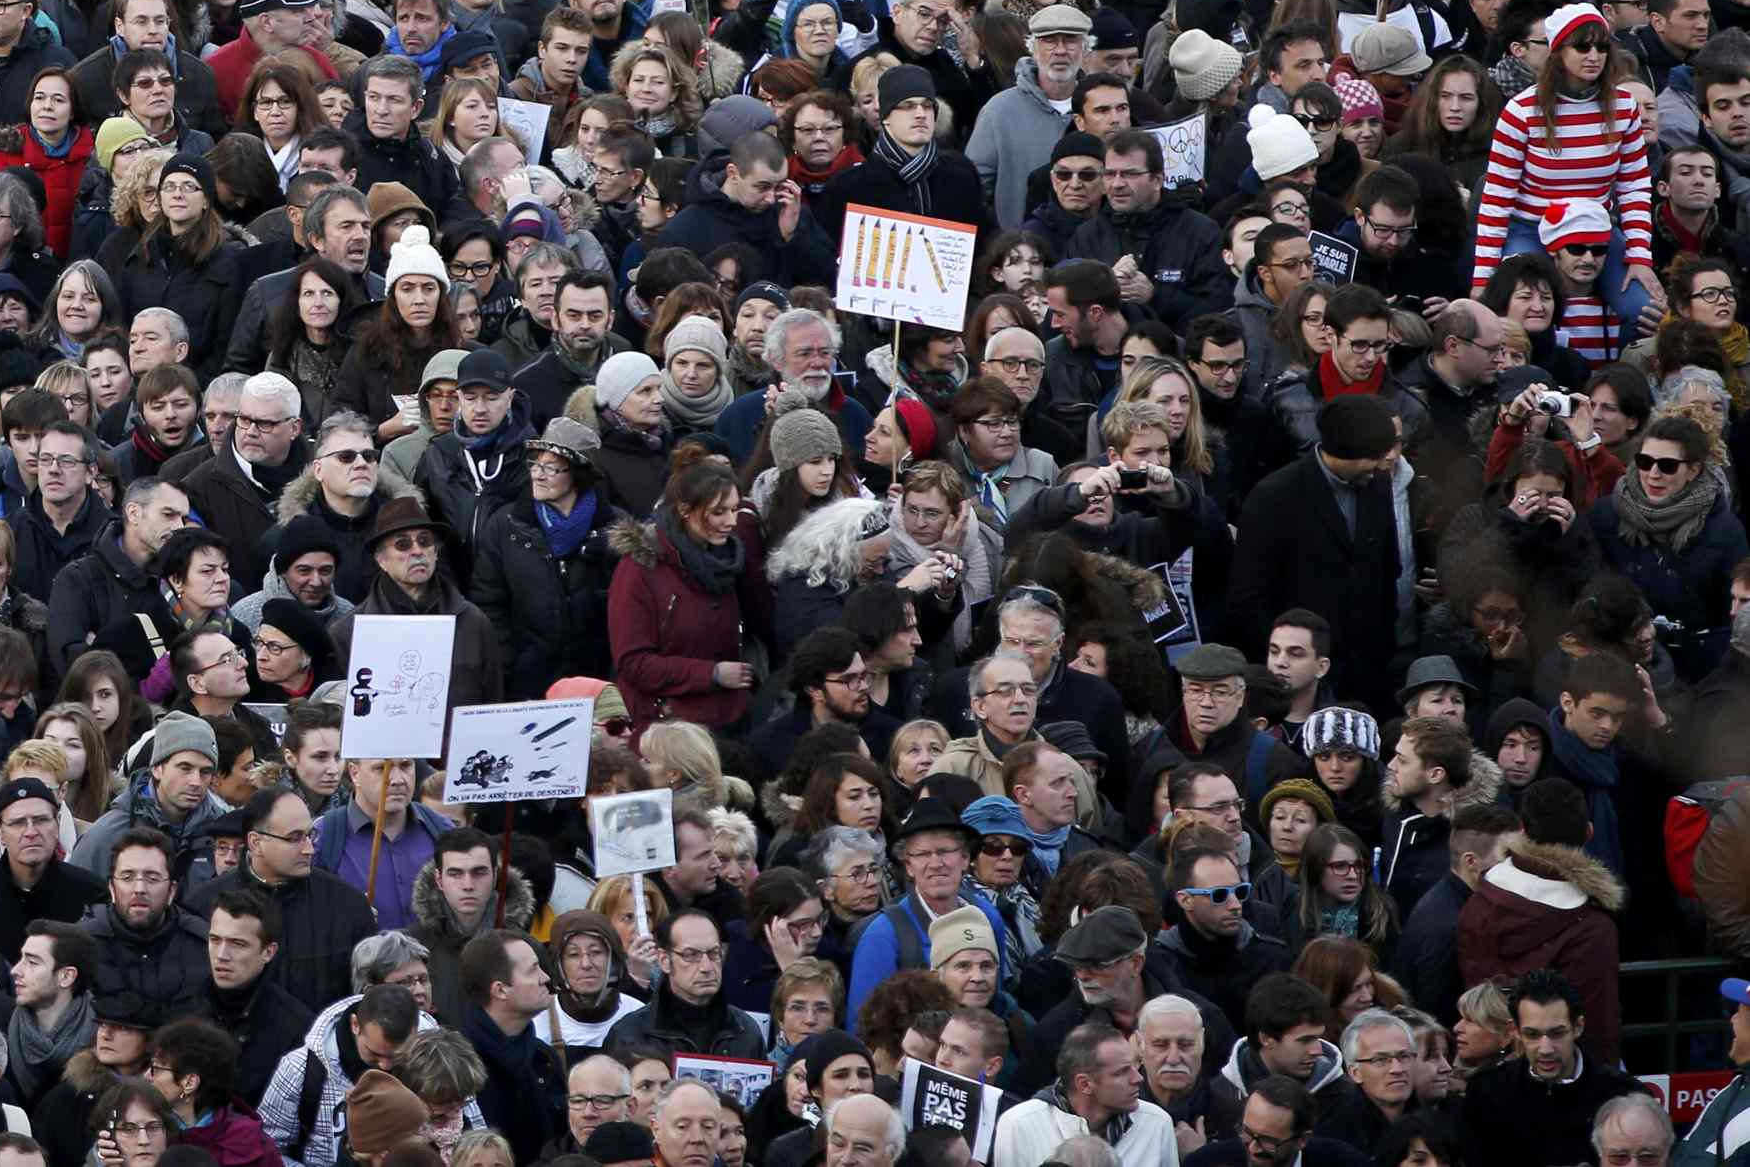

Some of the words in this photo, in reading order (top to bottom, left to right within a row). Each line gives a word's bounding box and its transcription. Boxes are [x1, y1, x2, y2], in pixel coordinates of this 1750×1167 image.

[1316, 244, 1330, 256] JE
[1329, 247, 1349, 263] SUIS
[928, 1080, 969, 1102] MÊME
[924, 1093, 967, 1120] PAS
